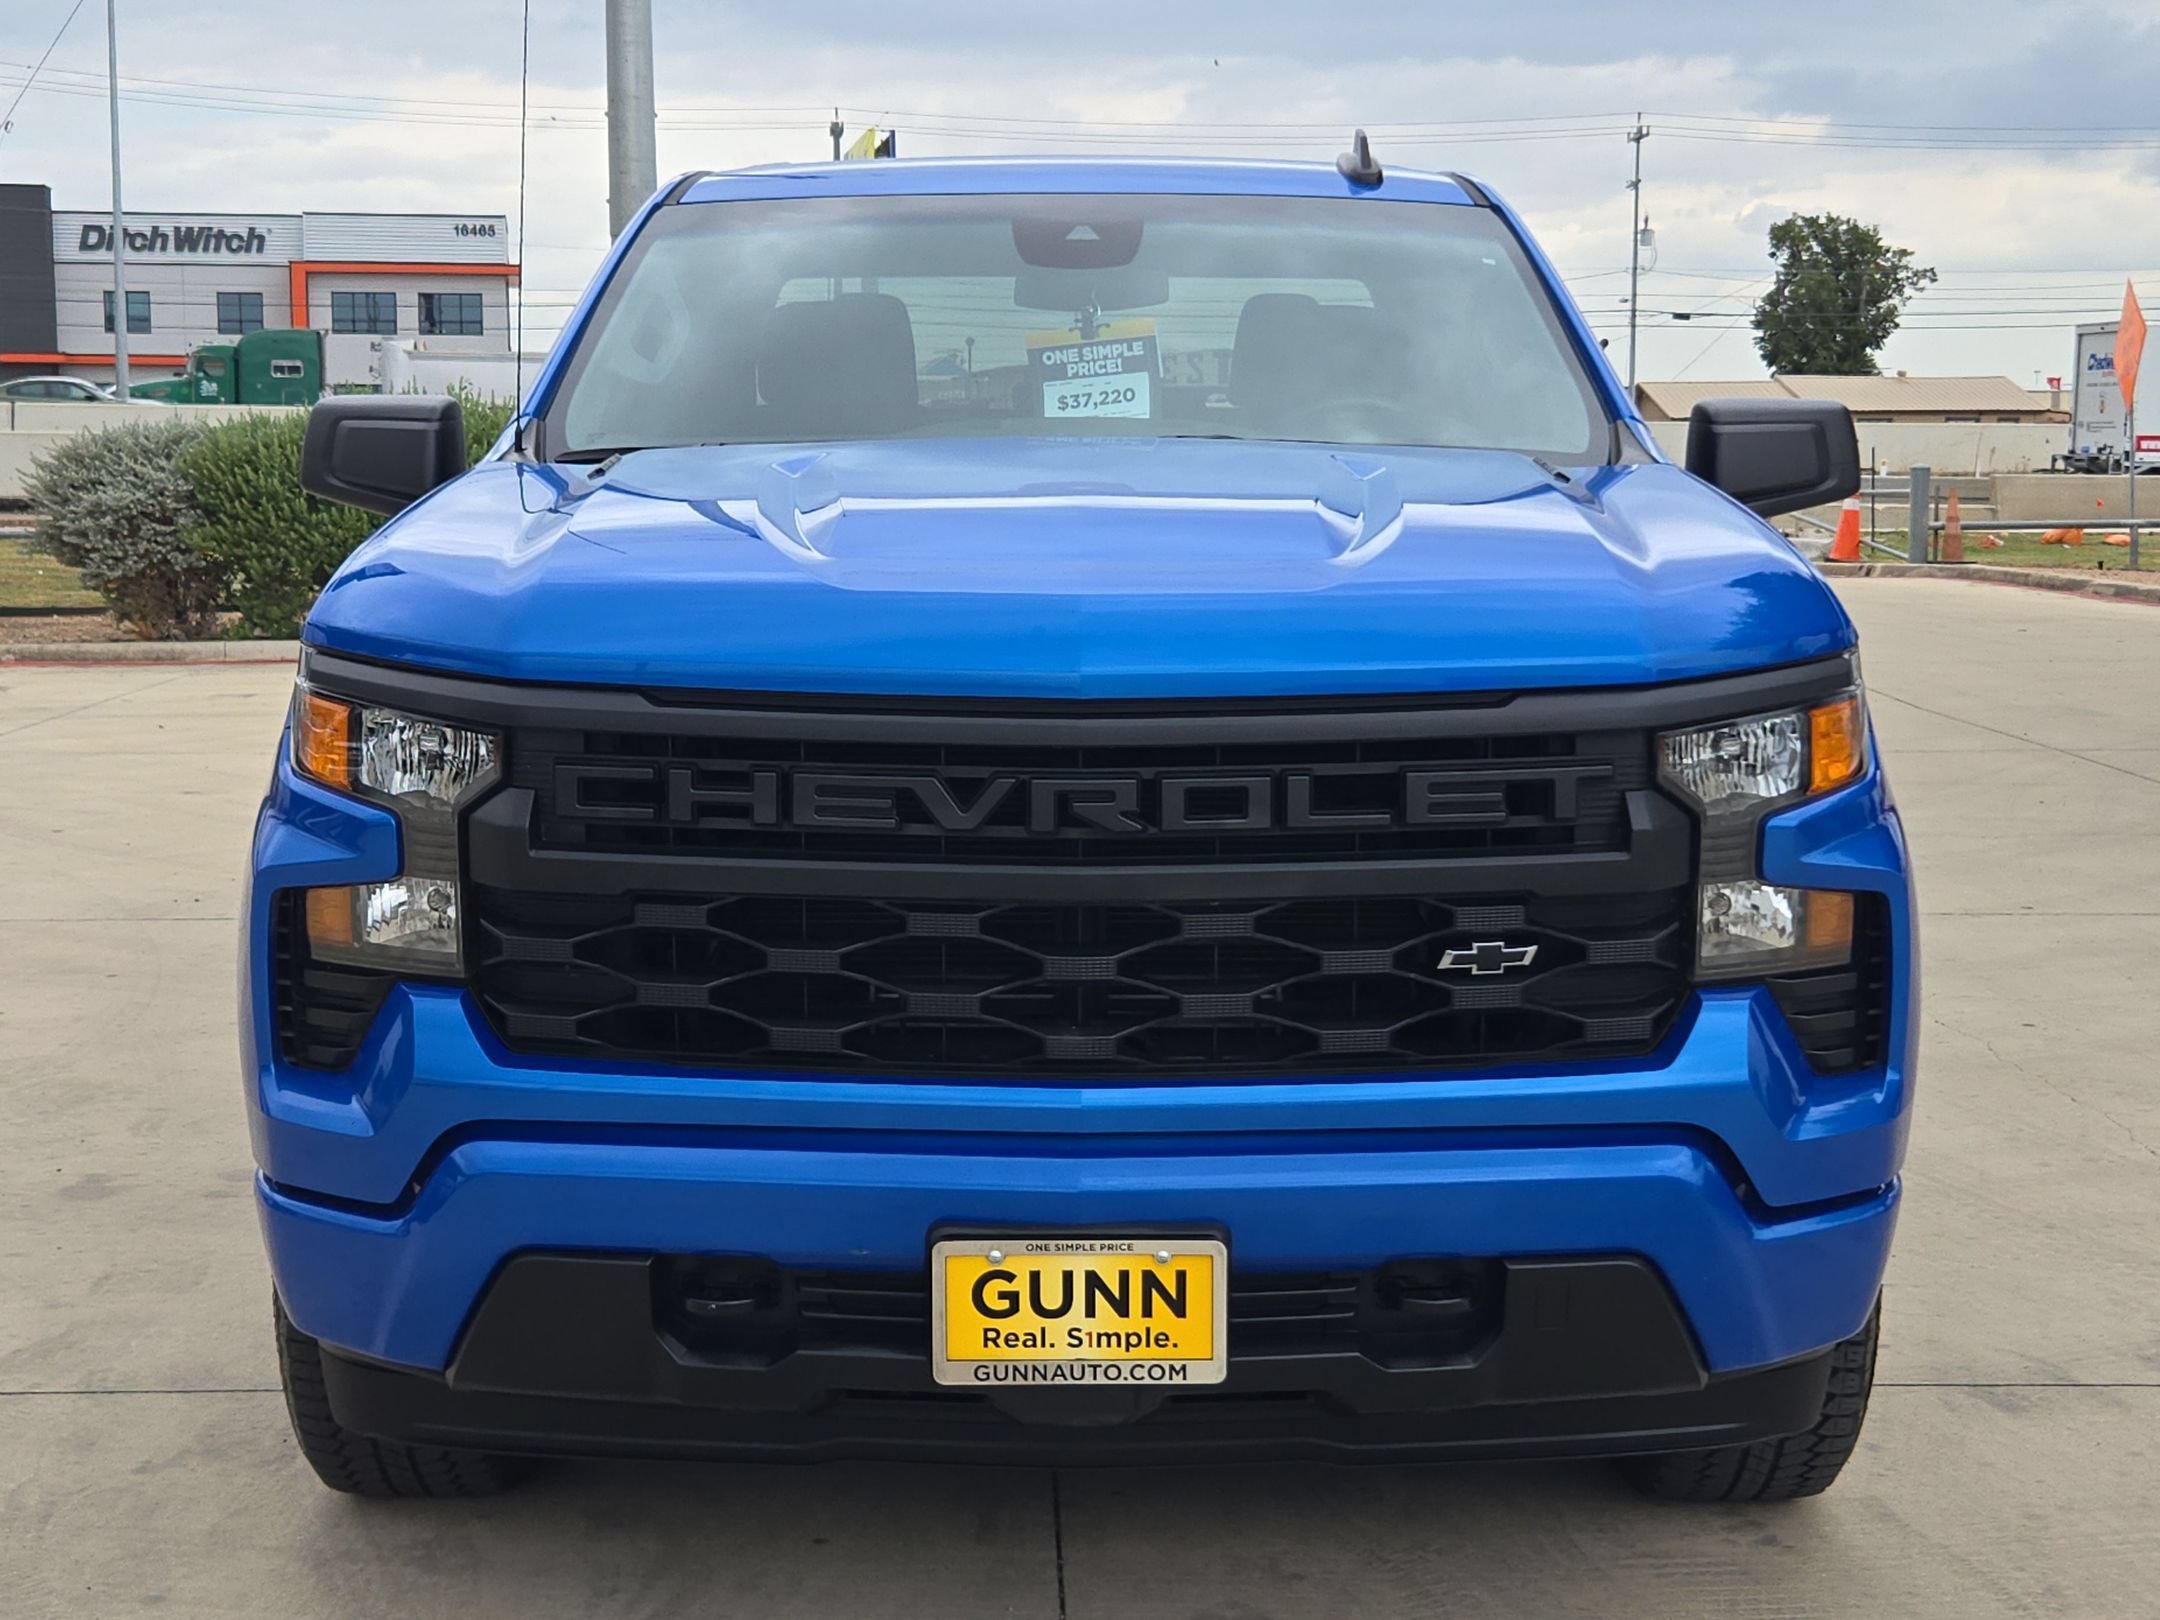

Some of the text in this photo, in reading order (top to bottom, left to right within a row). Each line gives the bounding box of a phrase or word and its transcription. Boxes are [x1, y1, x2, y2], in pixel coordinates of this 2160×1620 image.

[173, 226, 266, 254] Witch
[1042, 341, 1144, 365] ONE SIMPLE
[1066, 358, 1123, 377] PRICE!
[1056, 387, 1136, 412] $37,220
[554, 763, 1613, 836] CHEVROLET
[1025, 1243, 1135, 1252] ONE SIMPLE PRICE
[971, 1269, 1187, 1319] GUNN
[982, 1327, 1055, 1349] Real.
[973, 1364, 1187, 1382] GUNNAUTO.COM
